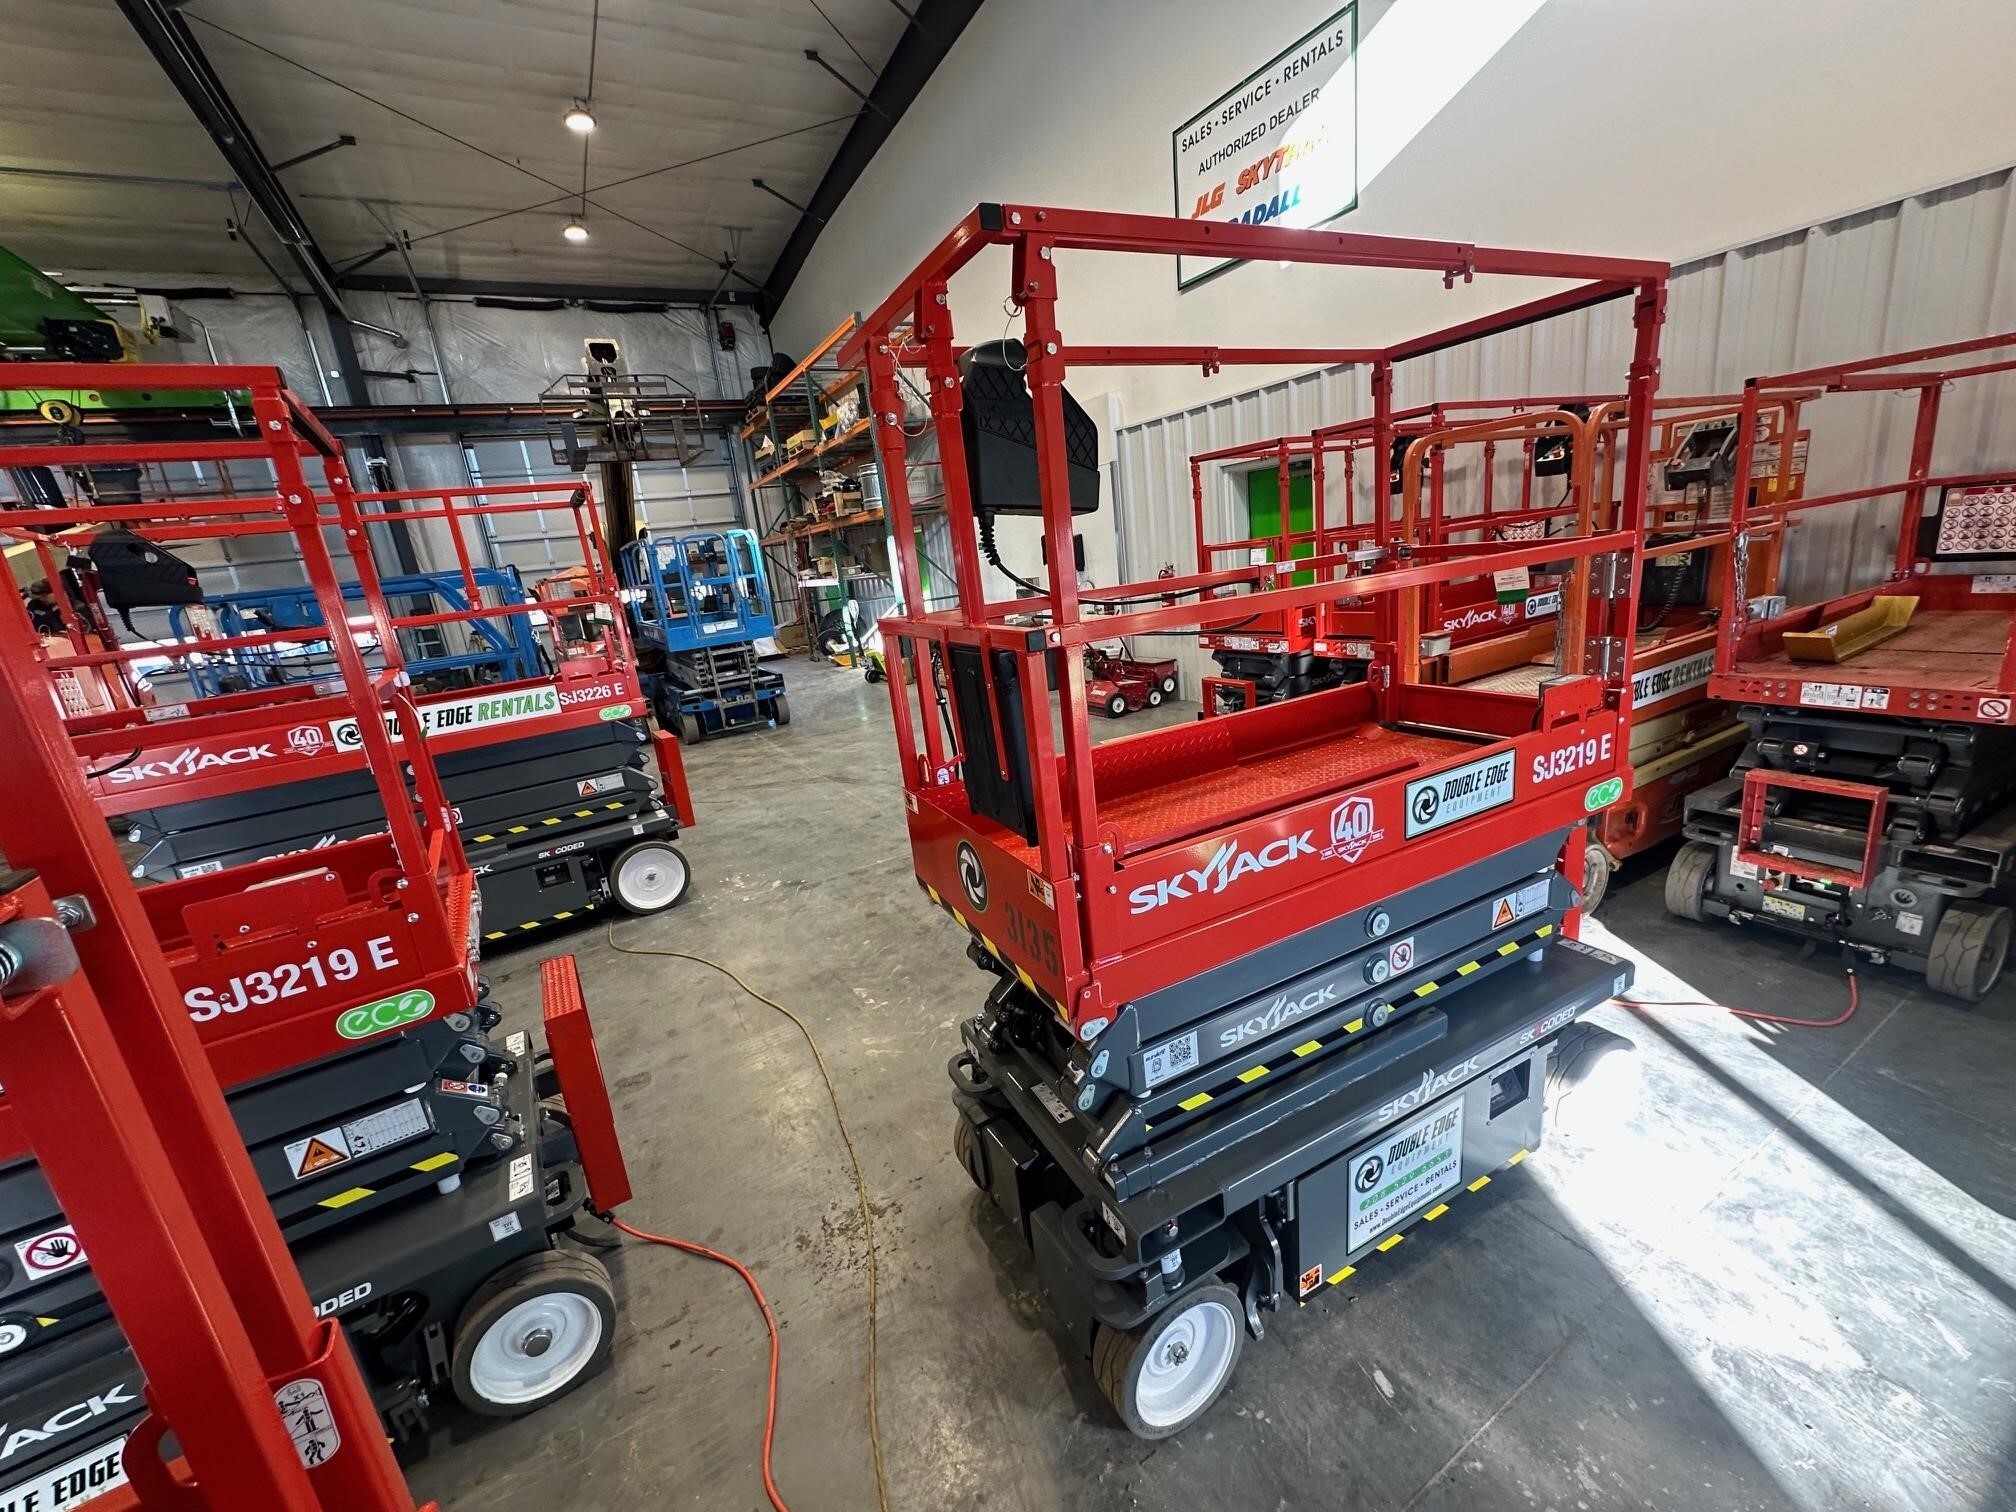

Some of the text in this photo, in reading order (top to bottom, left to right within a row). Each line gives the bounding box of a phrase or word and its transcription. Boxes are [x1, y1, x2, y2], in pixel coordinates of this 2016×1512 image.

[1182, 29, 1343, 153] SALES SERVICE RENTALS
[1198, 87, 1320, 176] AUTHORIZED DEALER
[1191, 182, 1226, 218] JLG
[1443, 608, 1497, 632] SKYJACK
[559, 682, 625, 706] SJ3226 E
[1651, 669, 1673, 696] EDGE
[437, 705, 473, 729] EDGE
[477, 691, 556, 722] RENTALS
[292, 729, 317, 746] 40
[1532, 733, 1611, 784] SJ3219 E
[108, 743, 277, 785] SKYJACK
[1443, 760, 1511, 803] DOUBLE EDGE
[1335, 804, 1367, 841] 40
[1446, 786, 1502, 814] EQUIPMENT
[1128, 829, 1317, 915] SKYJACK
[1004, 902, 1059, 977] 3135
[184, 935, 399, 1022] SJ3219 E
[1220, 983, 1337, 1048] SKYJACK
[1378, 1056, 1479, 1122] SKYJACK
[1387, 1107, 1459, 1166] DOUBLE EDGE
[1391, 1131, 1449, 1175] EQUIPMENT
[1353, 1160, 1457, 1230] SALES SERVICE RENTALS
[51, 1451, 120, 1506] EDGE
